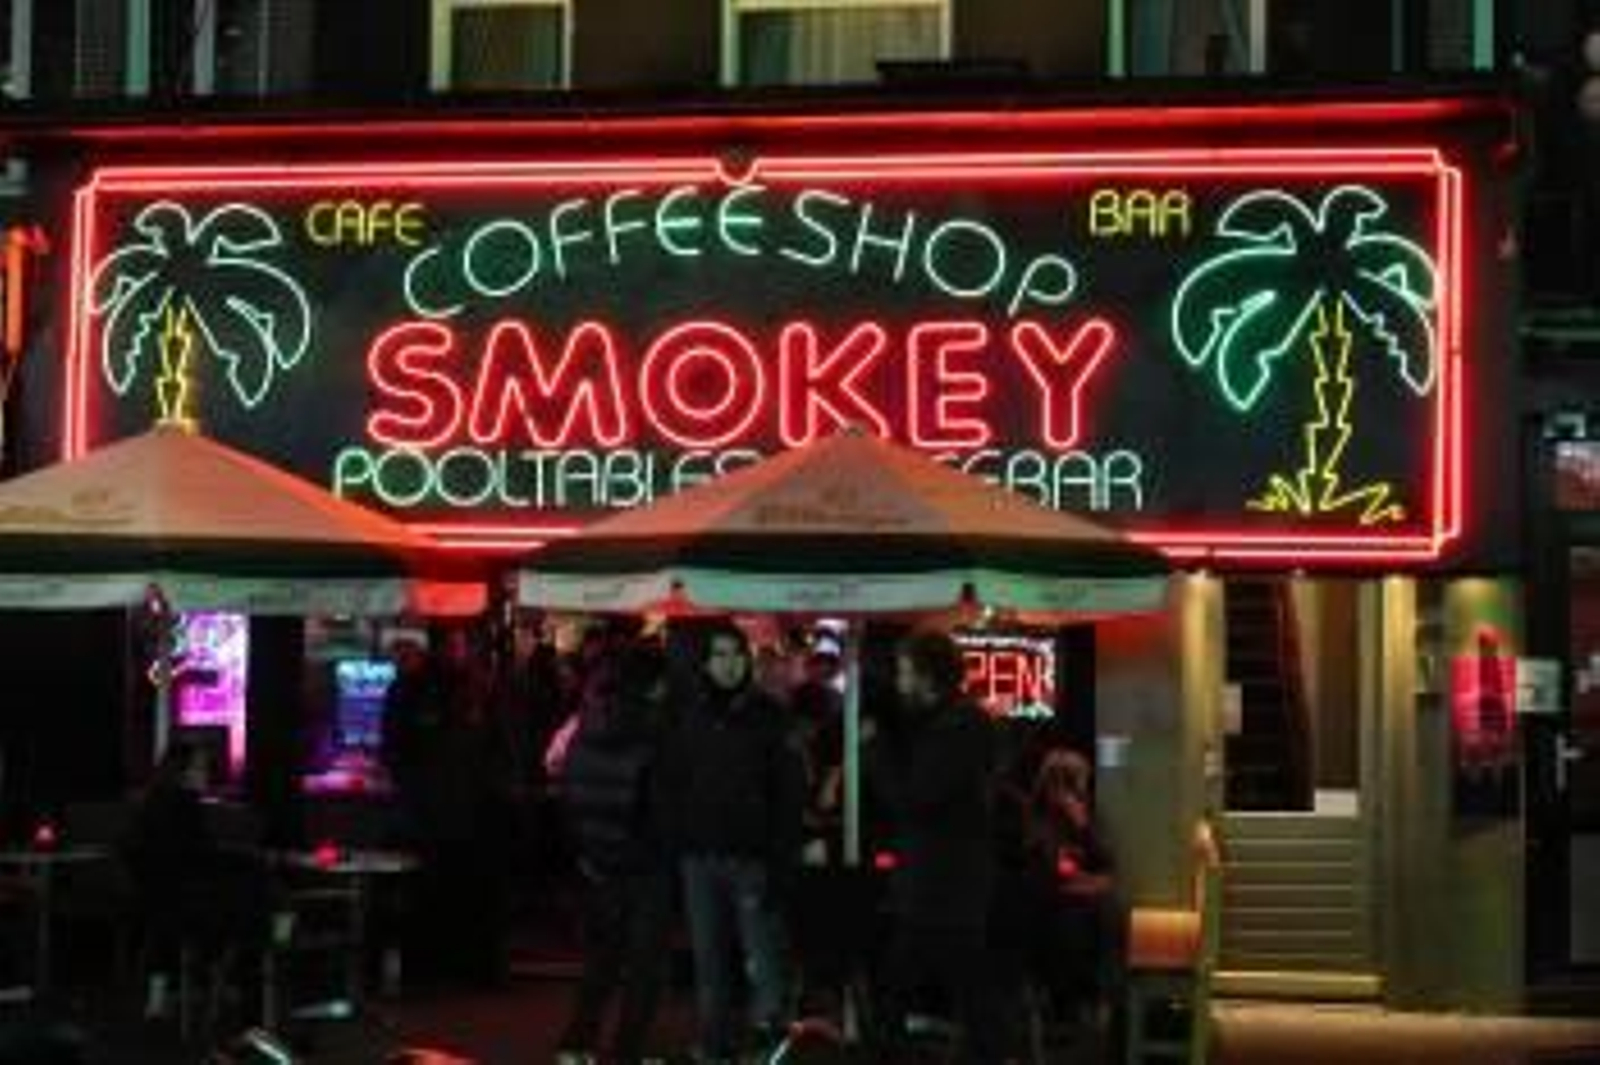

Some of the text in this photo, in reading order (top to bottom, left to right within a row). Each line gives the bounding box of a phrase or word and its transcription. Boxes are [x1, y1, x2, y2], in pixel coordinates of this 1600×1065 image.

[306, 201, 425, 246] CAFE
[404, 185, 1078, 318] COFFEESHOP
[1089, 189, 1192, 236] BAR
[367, 321, 1116, 450] SMOKEY
